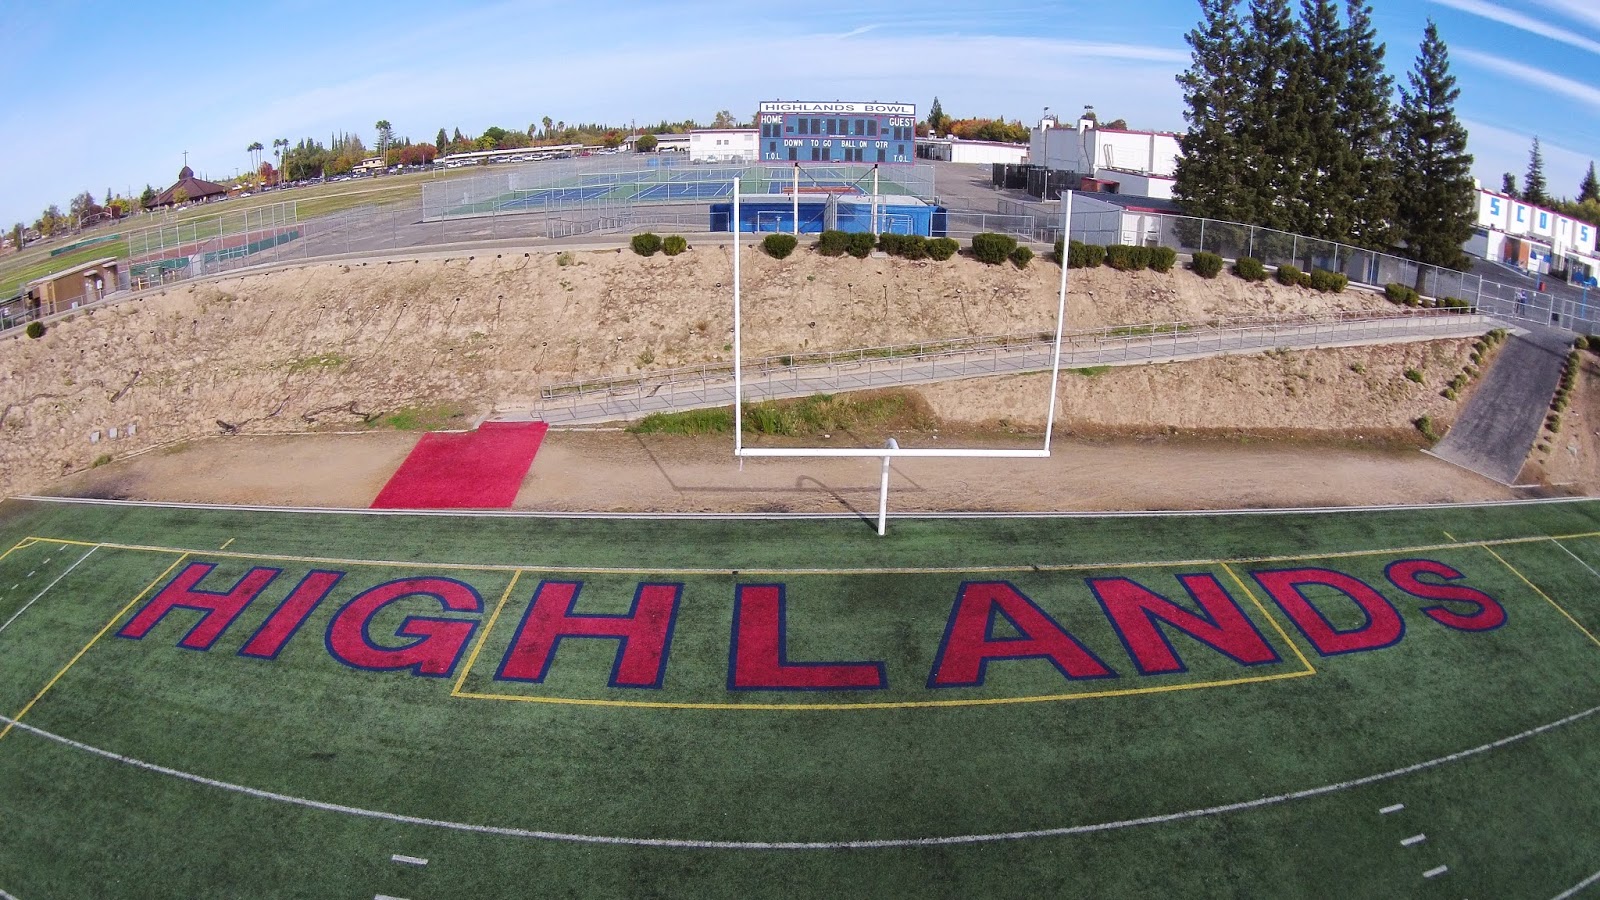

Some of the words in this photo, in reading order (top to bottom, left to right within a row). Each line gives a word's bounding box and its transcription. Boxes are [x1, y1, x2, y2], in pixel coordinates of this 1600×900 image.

[765, 104, 855, 112] HIGHLANDS
[864, 105, 910, 113] BOWL
[761, 115, 783, 124] HOME
[889, 117, 914, 127] GUEST
[784, 139, 803, 147] DOWN
[811, 139, 819, 147] TO
[823, 139, 831, 147] GO
[841, 140, 856, 148] BALL
[859, 140, 868, 148] ON
[875, 141, 888, 149] QTR
[765, 152, 782, 160] T.O.L.
[893, 155, 910, 163] T.O.L.
[1490, 197, 1588, 242] SCOTS
[115, 559, 1508, 690] HIGHLANDS
